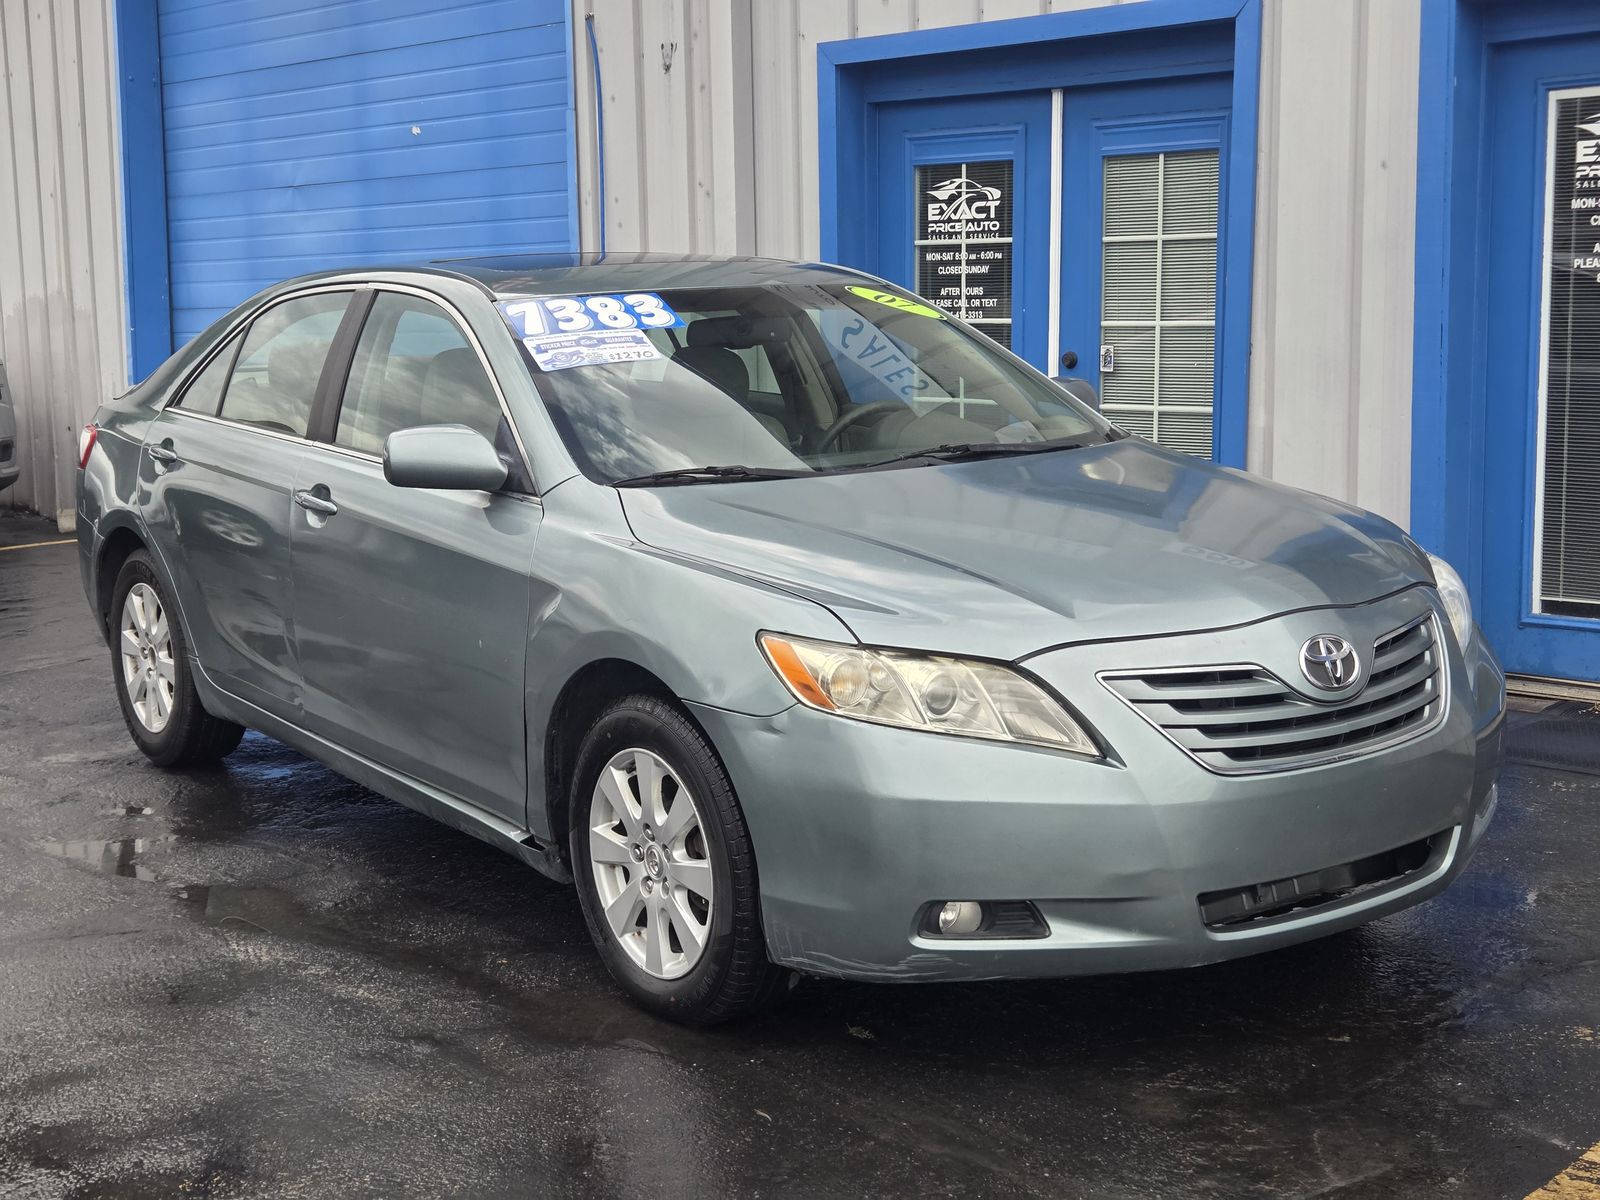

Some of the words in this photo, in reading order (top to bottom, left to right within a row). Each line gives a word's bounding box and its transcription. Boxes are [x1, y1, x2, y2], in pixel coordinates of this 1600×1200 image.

[928, 200, 1000, 221] EXACT
[928, 223, 963, 233] PRICE
[965, 221, 1000, 231] AUTO
[969, 232, 1000, 240] SERVICE
[926, 252, 954, 261] MON-SAT
[980, 251, 994, 260] 6:00
[938, 266, 964, 274] CLOSED
[964, 265, 989, 274] SUNDAY
[940, 287, 961, 296] AFTER
[962, 286, 984, 296] OURS
[970, 298, 981, 307] OR
[981, 298, 998, 307] TEXT
[506, 294, 676, 336] 7383
